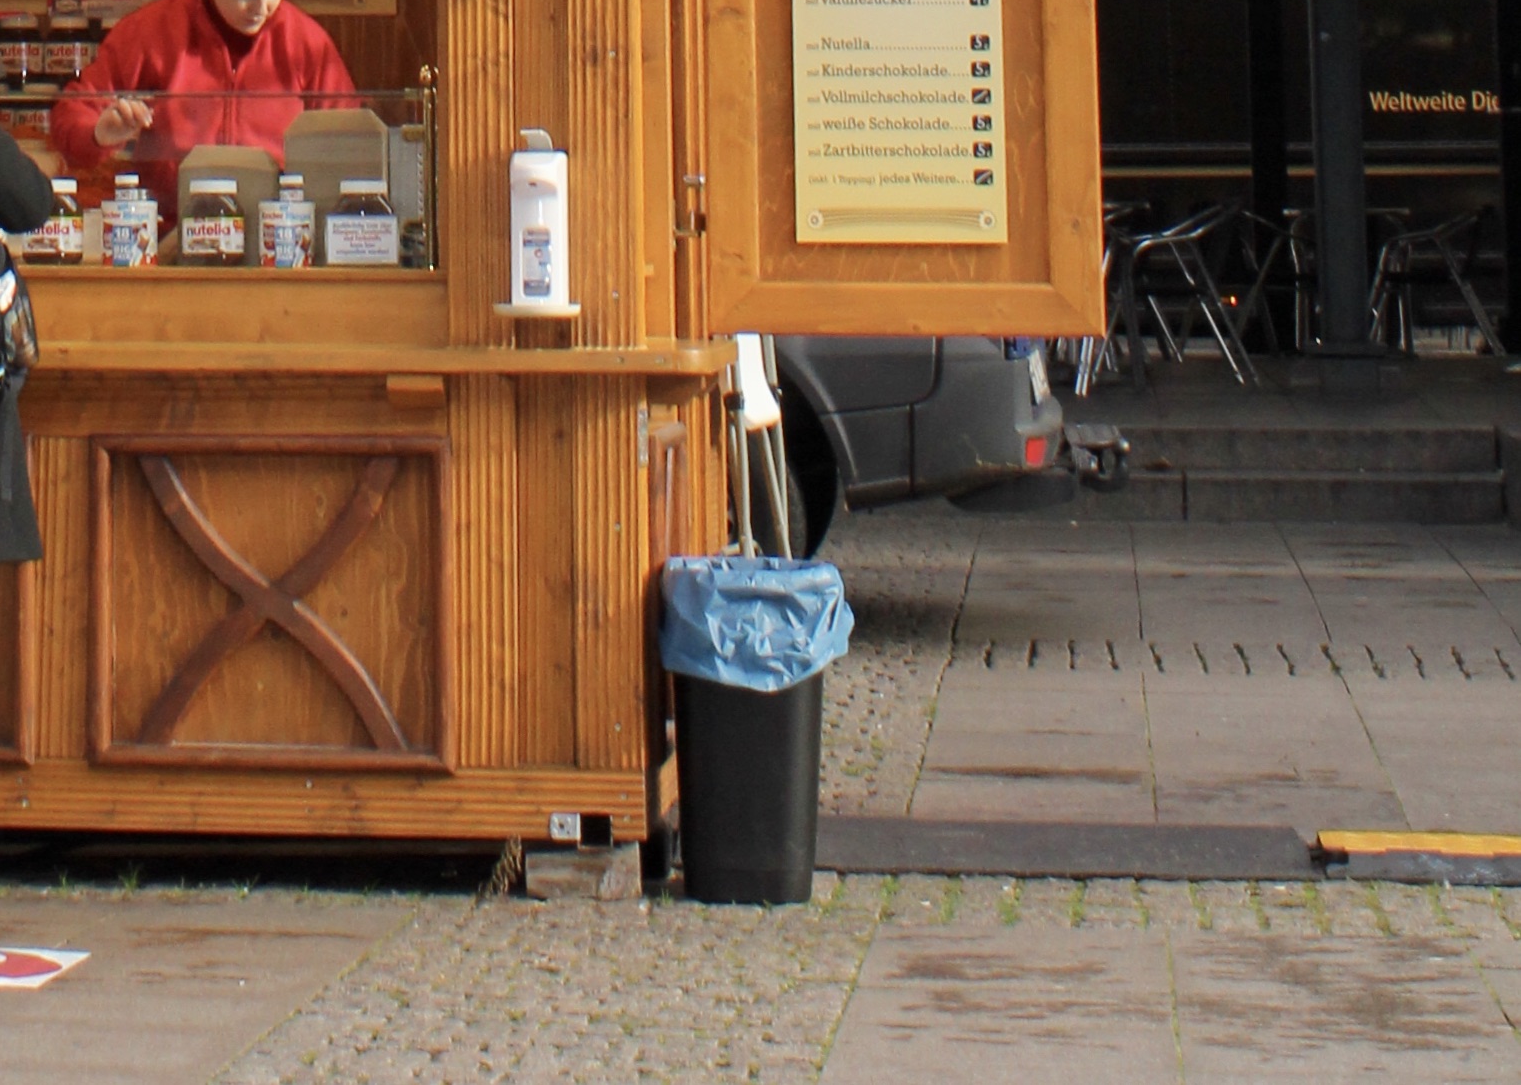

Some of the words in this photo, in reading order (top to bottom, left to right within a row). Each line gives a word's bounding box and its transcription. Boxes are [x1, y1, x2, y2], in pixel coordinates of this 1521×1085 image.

[821, 37, 871, 51] Nutella
[821, 63, 948, 78] Kinderschokolade
[821, 90, 966, 105] Vollmilchschokolade
[1369, 90, 1467, 112] Weltweite
[822, 117, 866, 131] weiße
[868, 117, 950, 131] Schokolade
[823, 143, 969, 158] Zartbitterschokolade
[878, 171, 910, 185] jedes
[912, 171, 957, 184] Weitere
[186, 221, 231, 236] nutella
